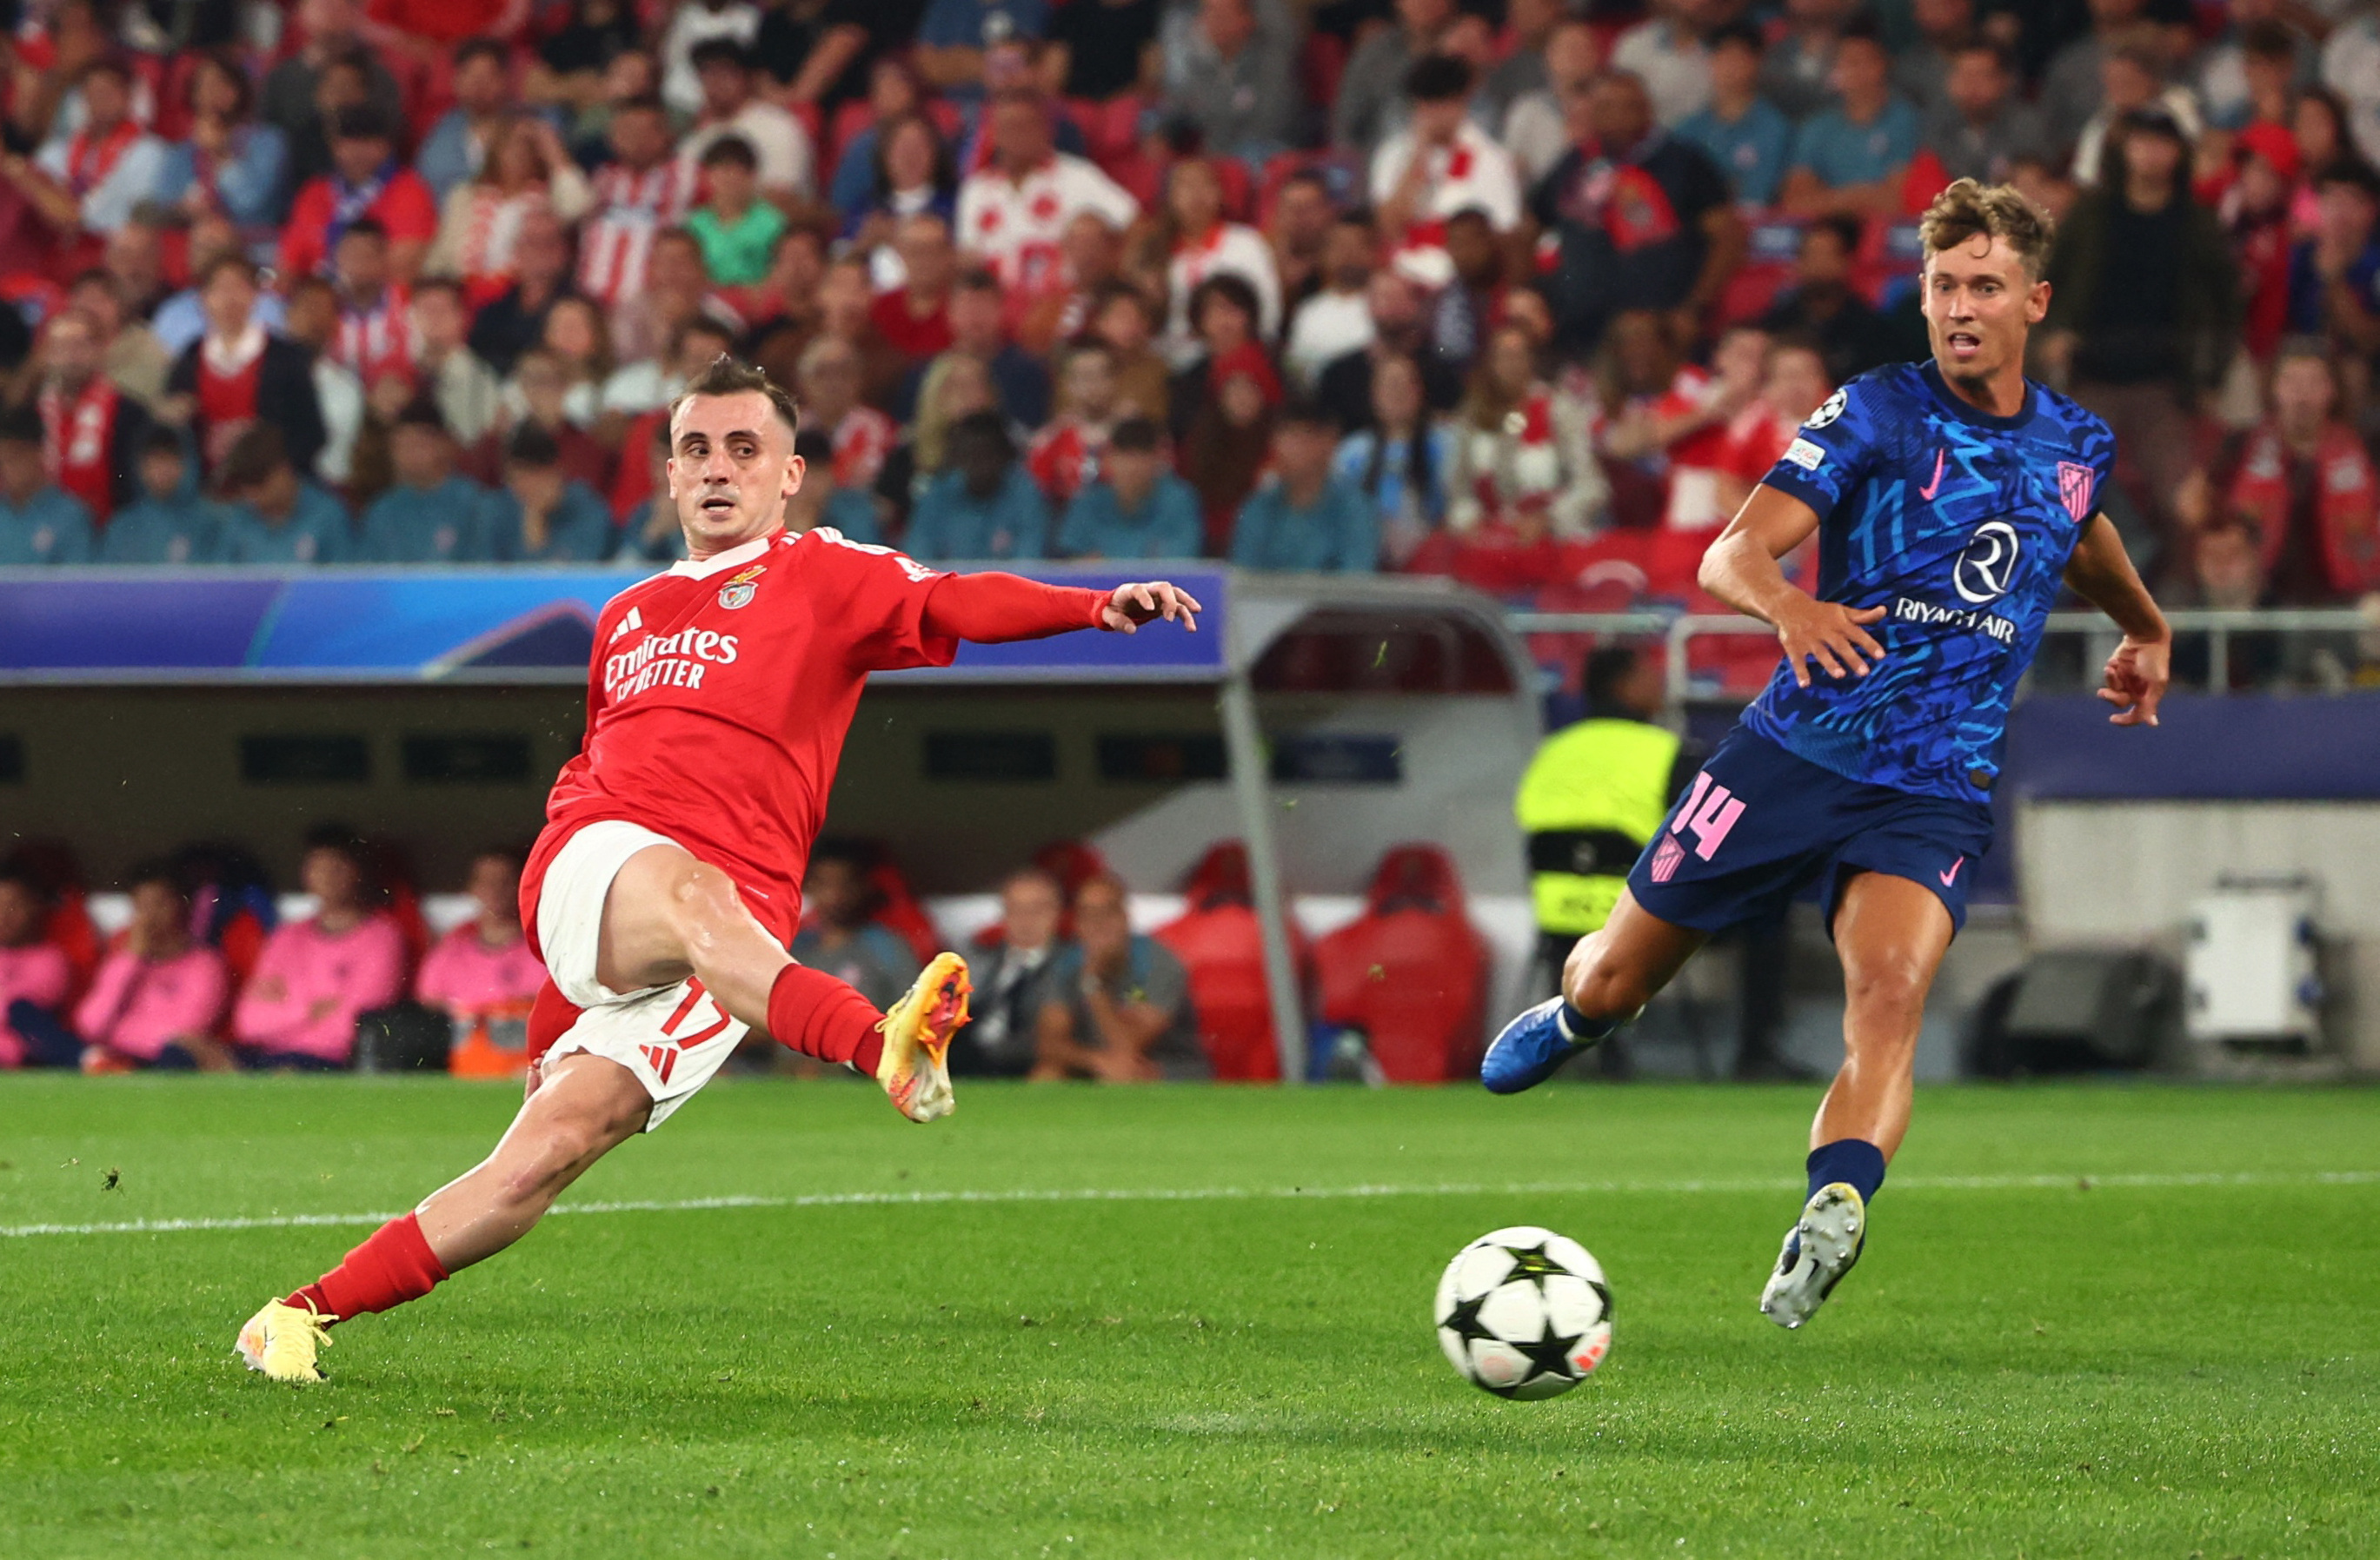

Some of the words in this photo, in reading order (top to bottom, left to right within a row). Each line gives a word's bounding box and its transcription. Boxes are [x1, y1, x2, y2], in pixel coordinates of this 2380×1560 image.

[1977, 614, 2015, 644] AIR
[604, 626, 739, 693] Emirates
[633, 659, 705, 694] BETTER
[1671, 770, 1746, 862] 14
